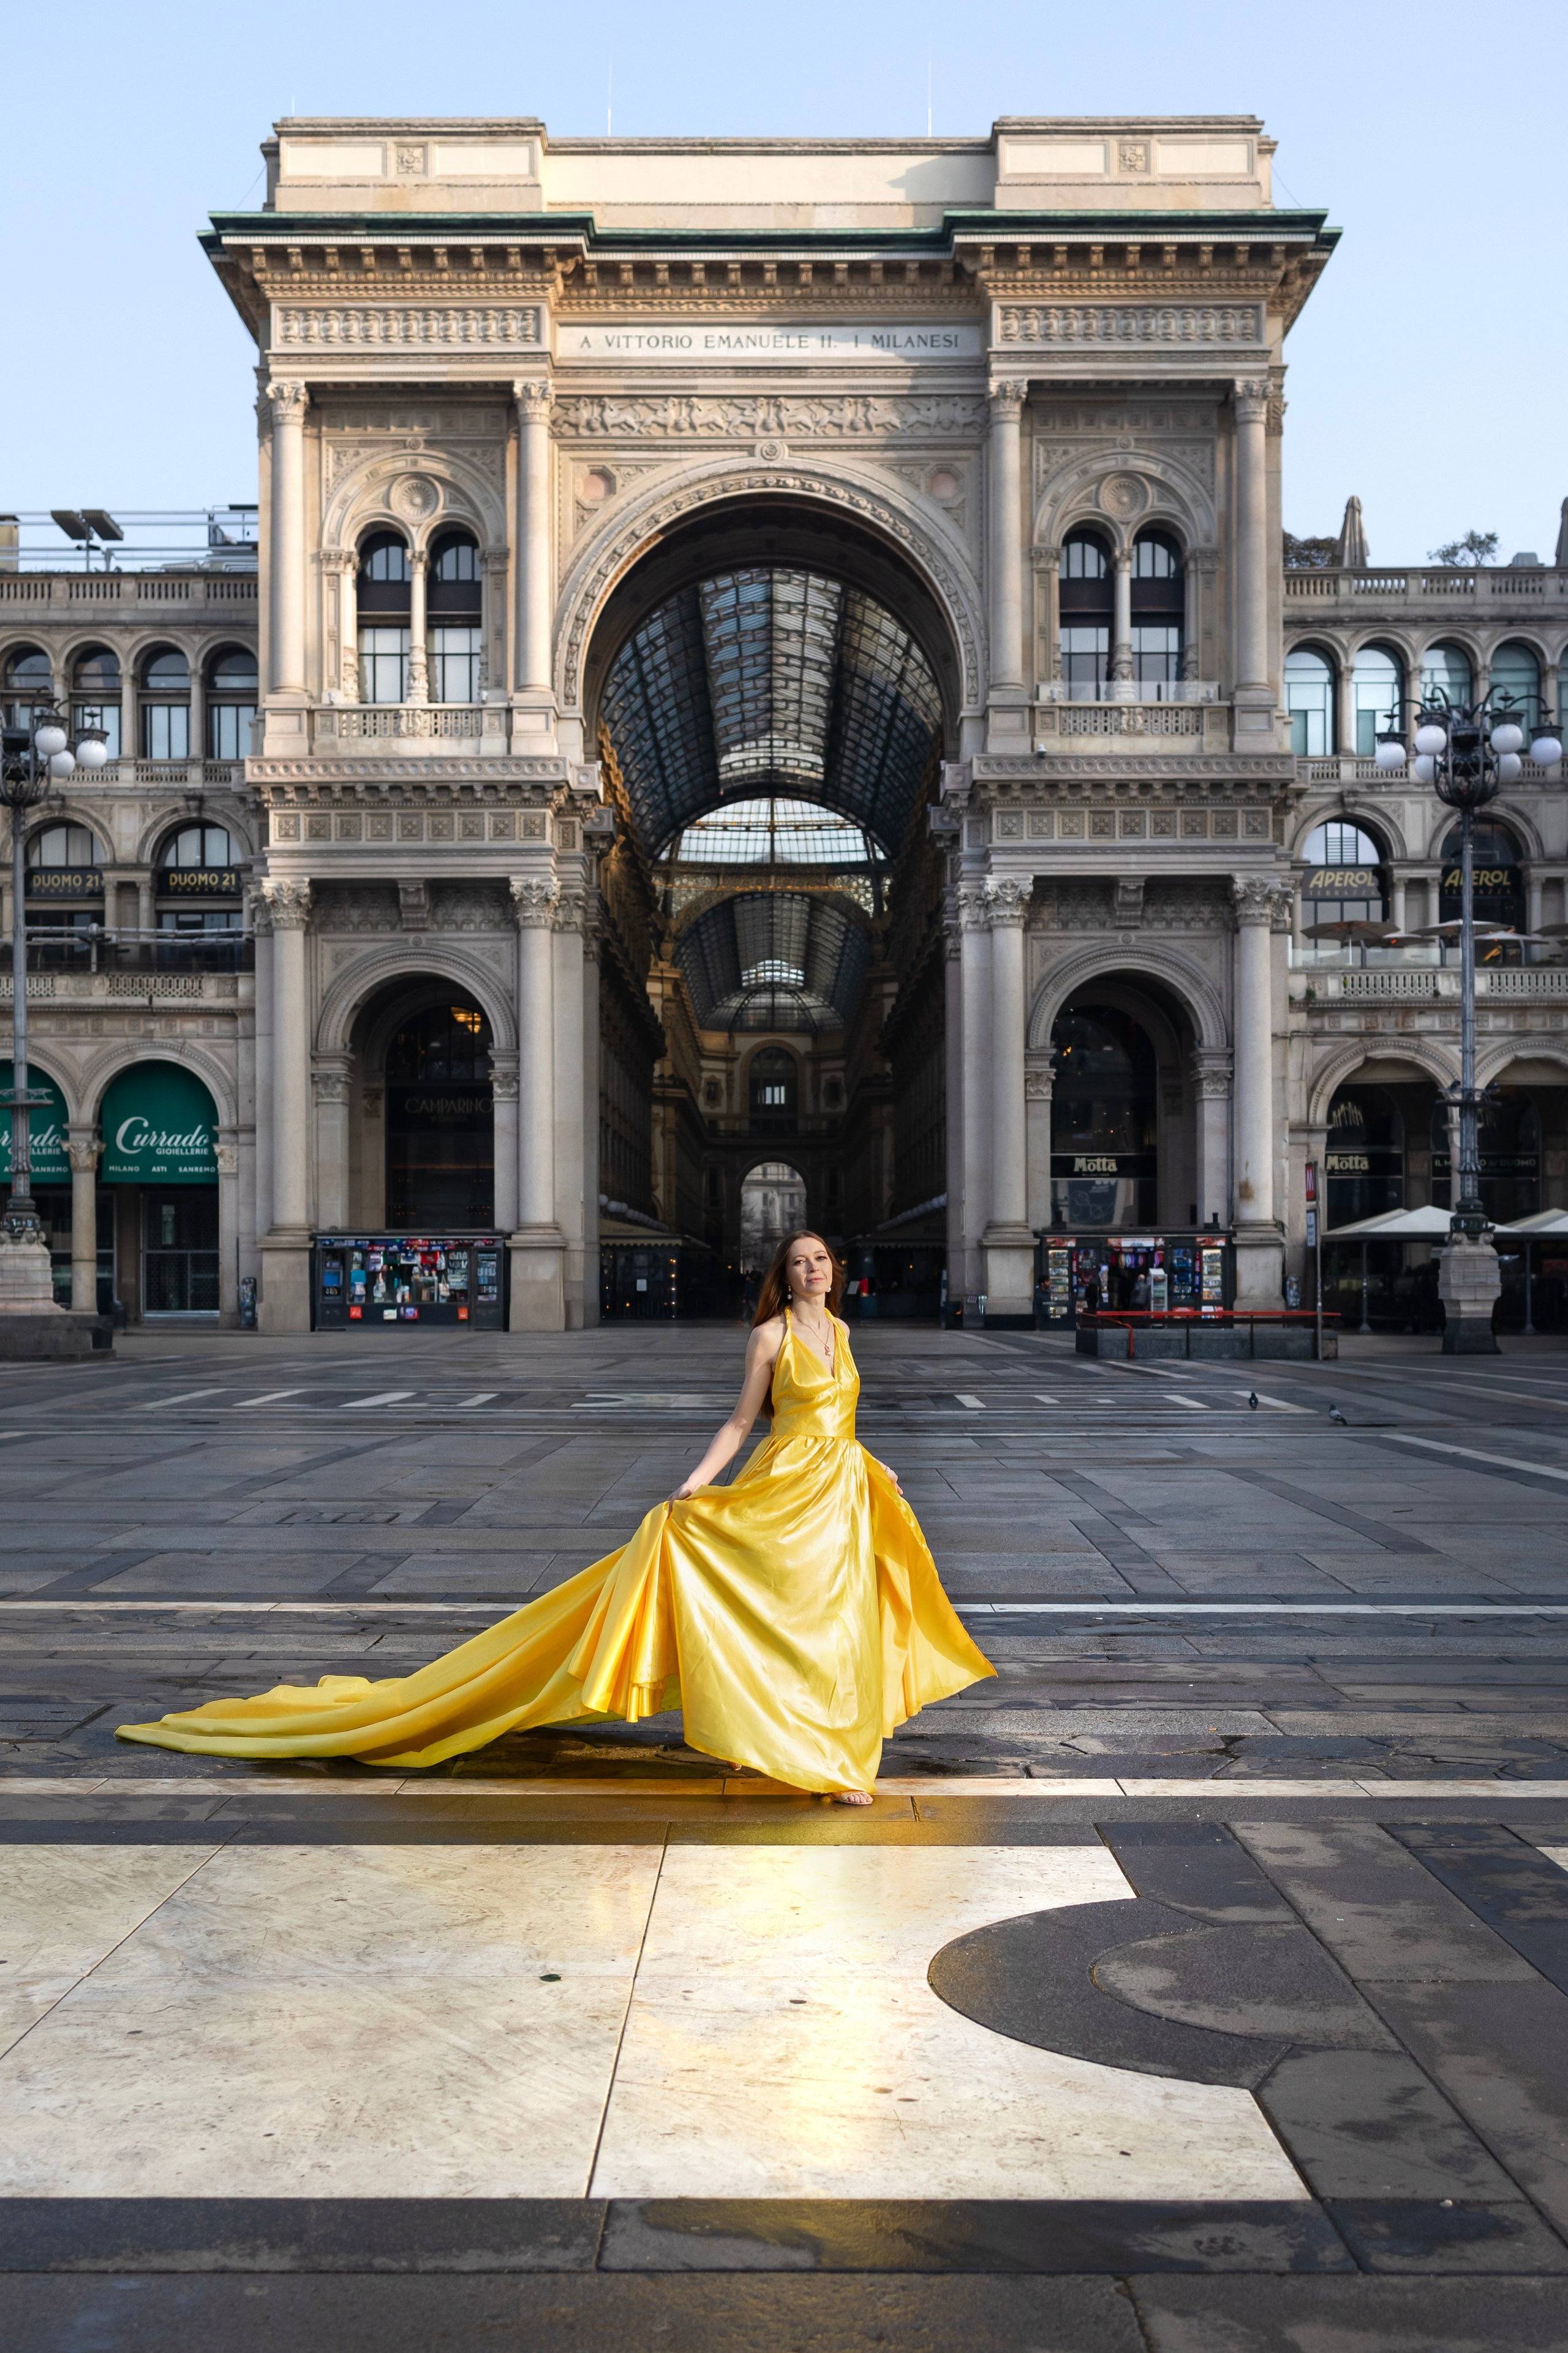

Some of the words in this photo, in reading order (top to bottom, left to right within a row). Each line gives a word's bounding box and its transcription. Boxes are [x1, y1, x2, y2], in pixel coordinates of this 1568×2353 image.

[580, 335, 592, 349] A
[605, 335, 692, 349] VITTORIO
[704, 334, 809, 349] EMANUELE
[872, 334, 959, 348] MILANESI
[32, 874, 82, 888] DUOMO
[86, 874, 99, 887] 21
[170, 873, 219, 886] DUOMO
[222, 873, 235, 886] 21
[1310, 870, 1376, 888] APEROL
[405, 1098, 493, 1113] CAMPARINO
[116, 1116, 209, 1154] Currado
[1074, 1157, 1118, 1172] Motta
[1327, 1155, 1370, 1170] Motta
[1306, 1169, 1314, 1192] M
